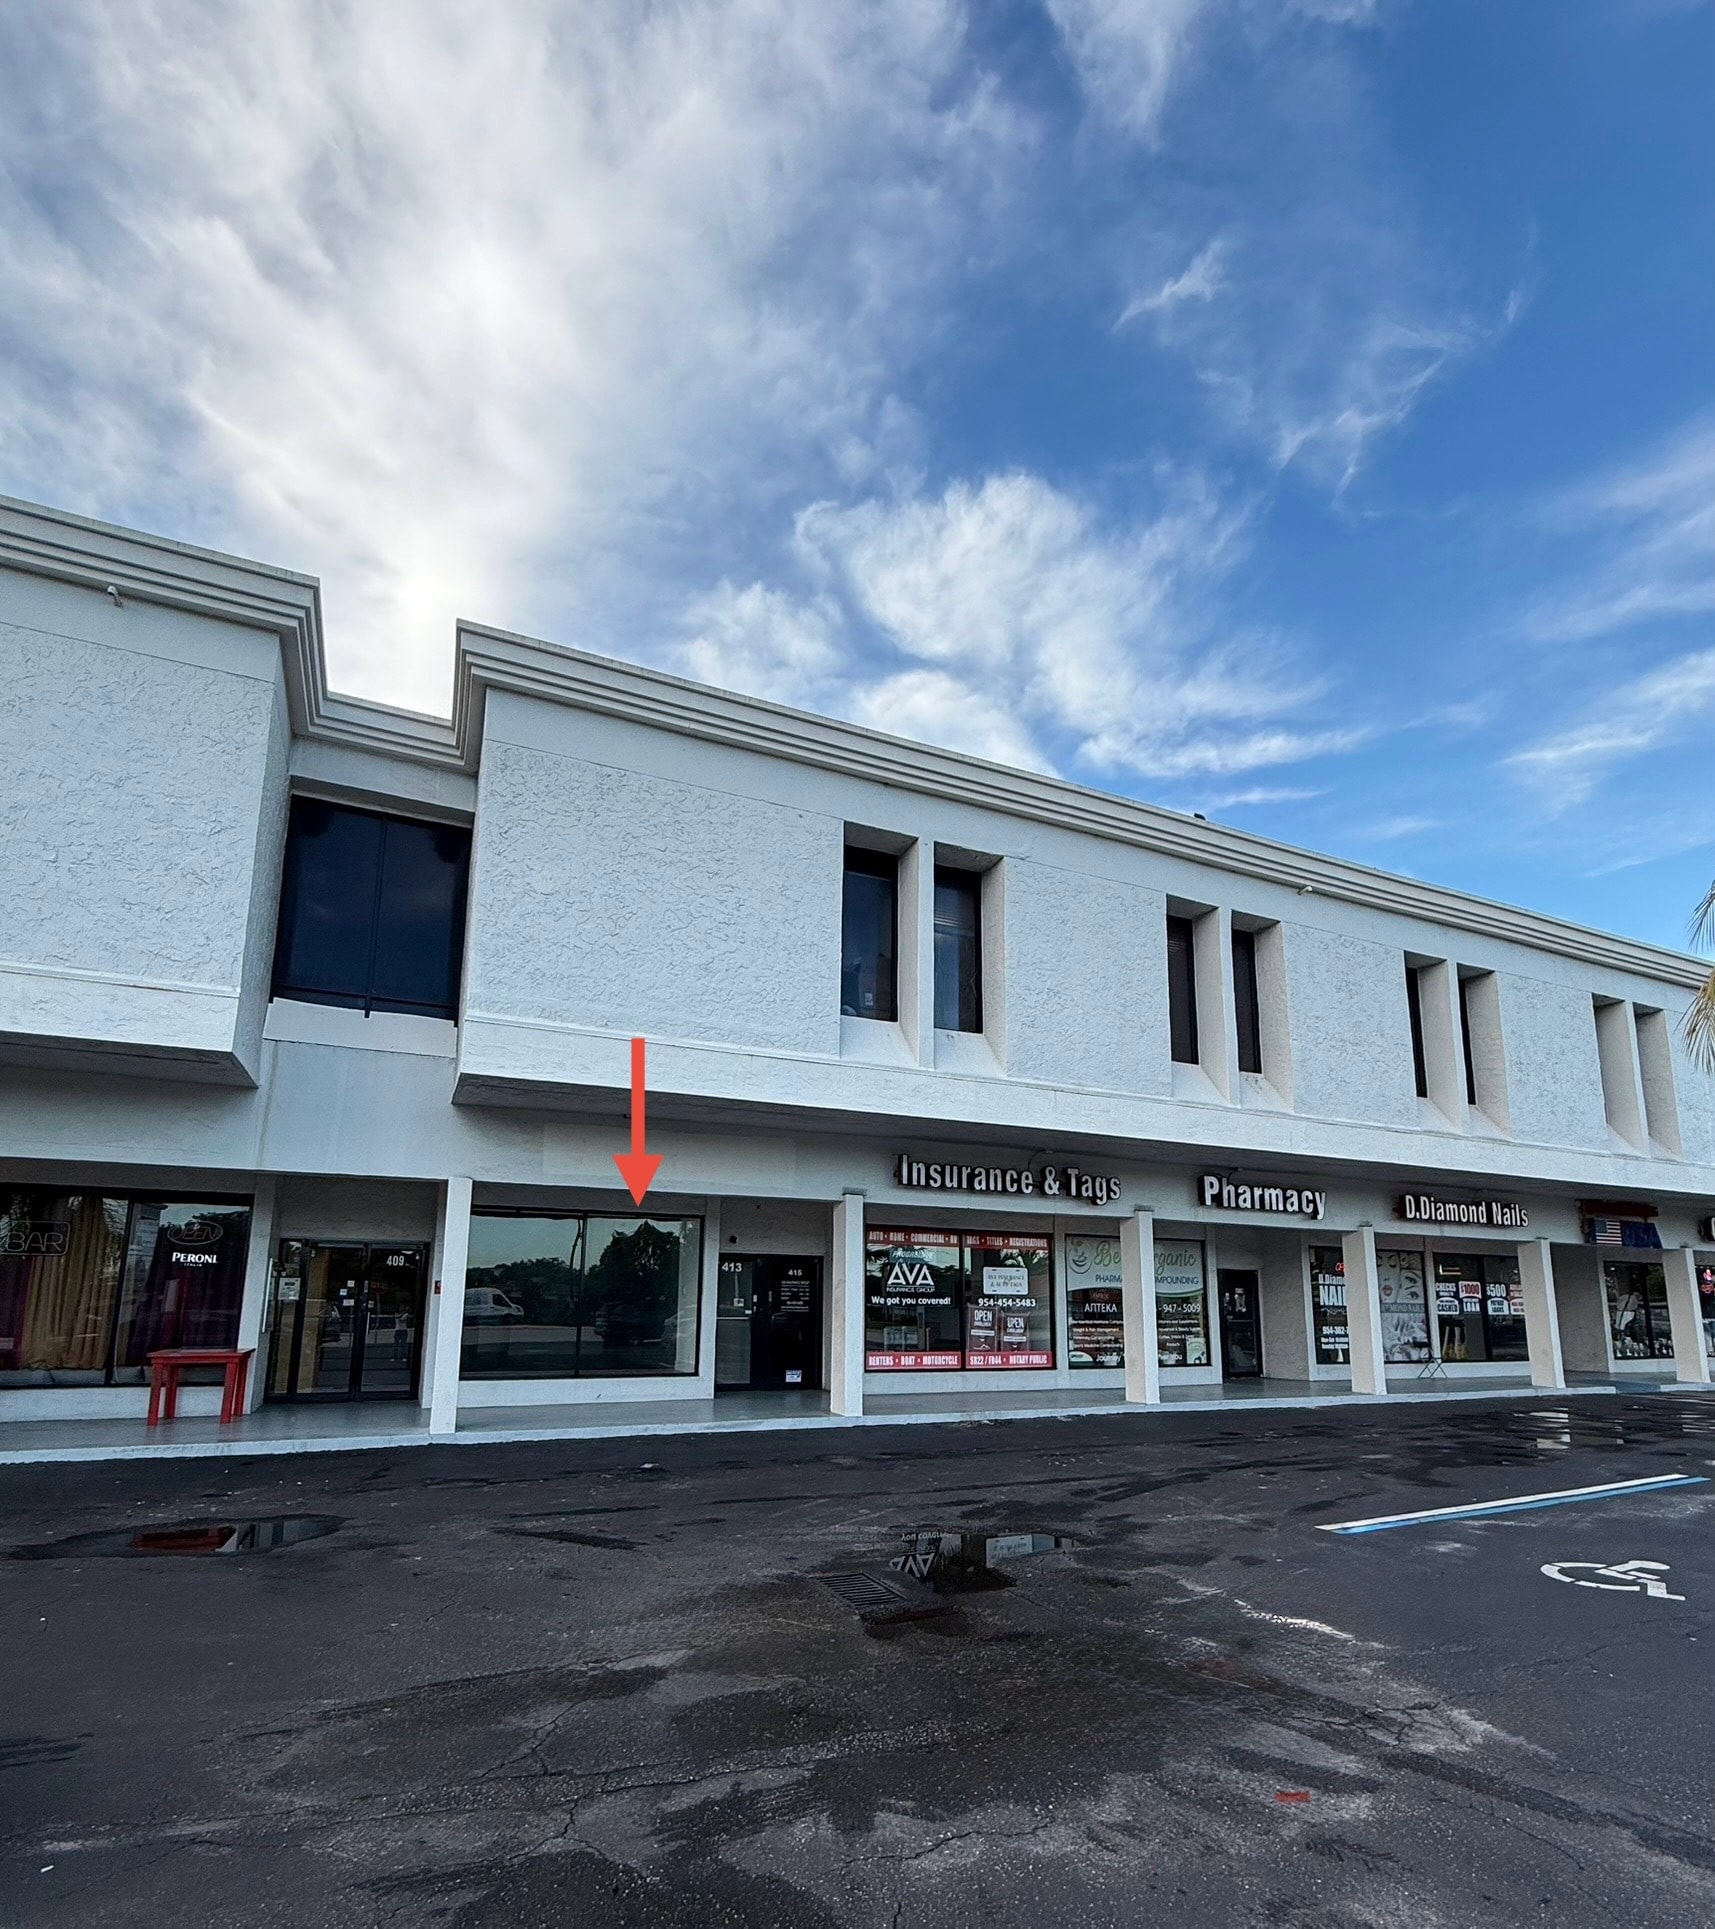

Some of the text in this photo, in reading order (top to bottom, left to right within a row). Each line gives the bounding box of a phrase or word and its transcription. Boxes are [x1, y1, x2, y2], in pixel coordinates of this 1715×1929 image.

[901, 1154, 1121, 1206] Insurance & Tags
[1203, 1175, 1326, 1220] Pharmacy
[1405, 1194, 1529, 1227] D.Diamond Nails
[170, 1225, 219, 1240] OPEN
[6, 1231, 63, 1252] BAR
[171, 1251, 219, 1264] PERONI
[386, 1255, 405, 1267] 409
[721, 1262, 743, 1273] 413
[887, 1262, 935, 1286] AVA
[1487, 1283, 1506, 1297] $500
[871, 1296, 951, 1306] We got you covered!
[978, 1298, 1036, 1307] 954-454-5483
[1084, 1303, 1118, 1313] АПТЕКА
[974, 1310, 993, 1322] OPEN
[1007, 1316, 1024, 1328] OPEN
